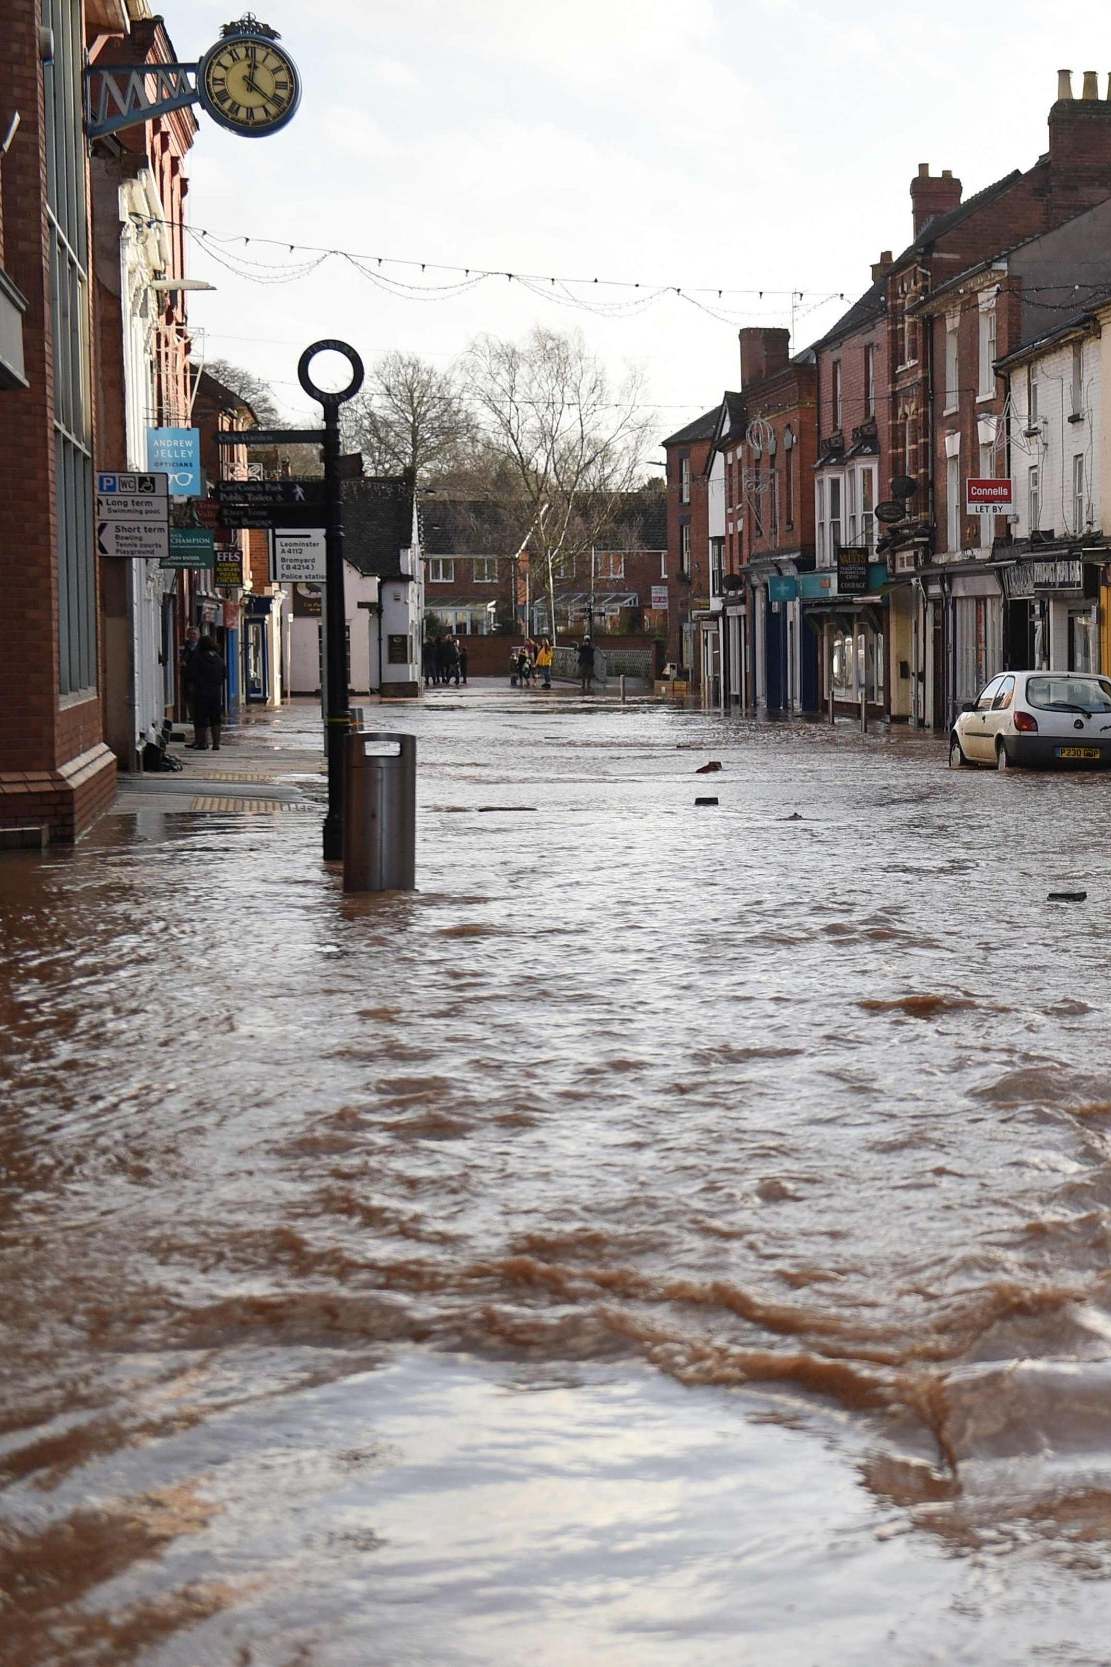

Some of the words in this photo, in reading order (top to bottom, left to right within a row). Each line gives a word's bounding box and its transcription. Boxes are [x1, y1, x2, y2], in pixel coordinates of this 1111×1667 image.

[153, 439, 193, 447] ANDREW
[153, 449, 194, 458] JELLEY
[120, 480, 136, 489] WC
[971, 486, 1008, 496] Connells
[106, 499, 128, 508] Long
[975, 505, 989, 513] LET
[992, 505, 1004, 513] BY
[217, 552, 240, 561] EFES
